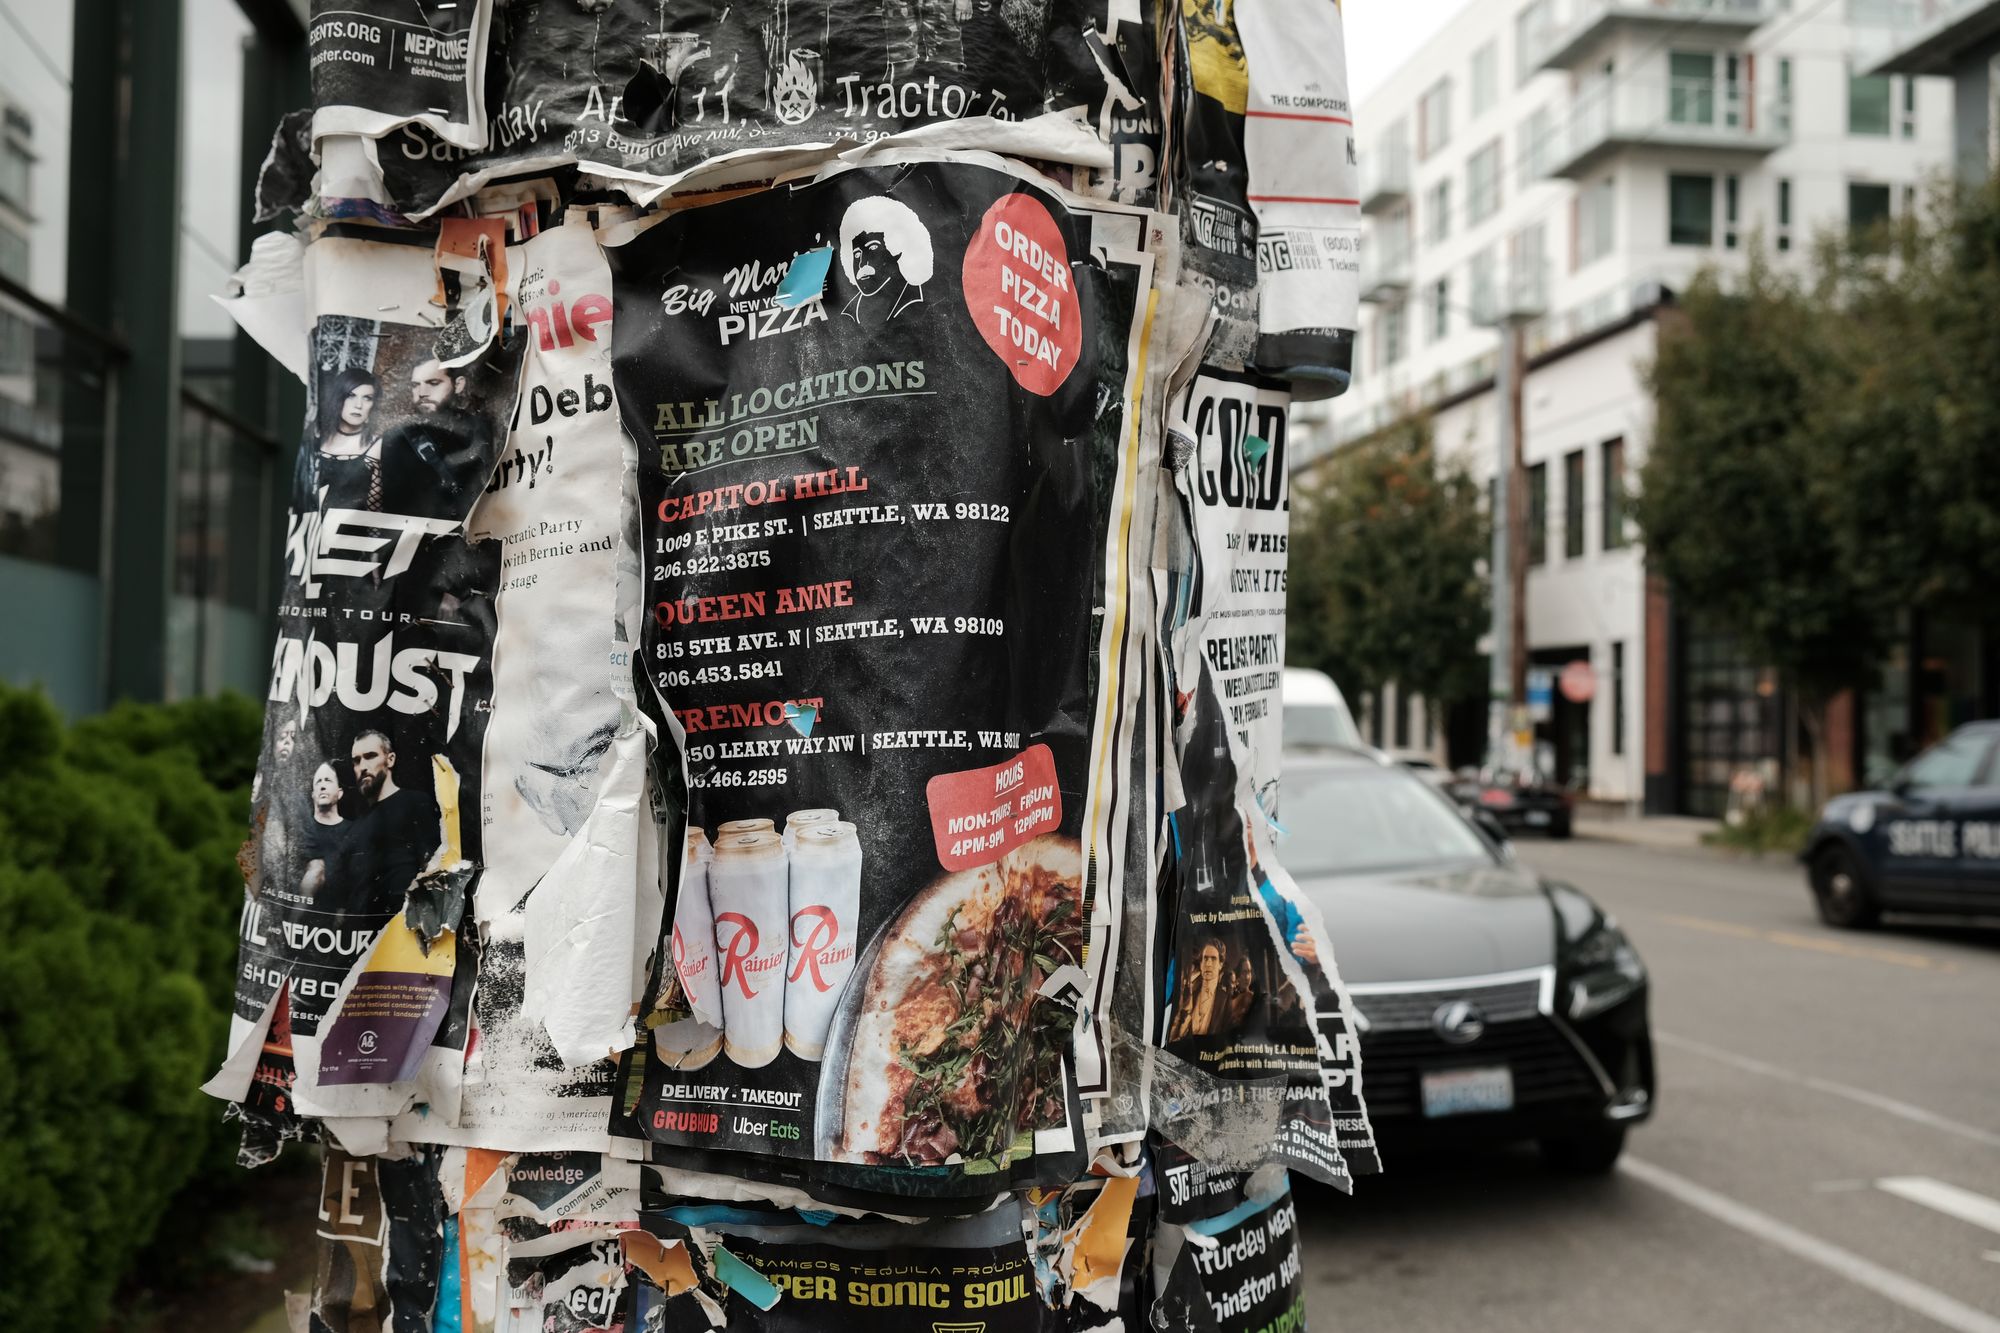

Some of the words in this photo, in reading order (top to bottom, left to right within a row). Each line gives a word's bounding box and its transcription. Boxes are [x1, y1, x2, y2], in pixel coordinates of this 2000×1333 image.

[837, 75, 981, 120] Tractor
[1271, 94, 1291, 107] THE
[562, 127, 600, 153] 5213
[994, 221, 1069, 293] ORDER
[661, 284, 717, 317] Big
[730, 299, 760, 315] NEW
[1001, 264, 1061, 331] PIZZA
[718, 299, 829, 346] PIZZA
[993, 305, 1062, 372] TODAY
[654, 400, 727, 431] ALL
[731, 360, 926, 420] LOCATIONS
[659, 434, 725, 471] ARE
[731, 416, 820, 456] OPEN
[656, 478, 787, 523] CAPITOL
[794, 466, 868, 500] HILL
[540, 519, 583, 538] Party
[656, 532, 692, 554] 1009
[695, 529, 708, 546] E
[712, 522, 760, 544] PIKE
[764, 518, 794, 537] ST.
[814, 505, 906, 530] SEATTLE,
[912, 503, 950, 521] WA
[955, 502, 1010, 523] 98122
[1247, 532, 1287, 553] WHIS
[503, 551, 527, 569] with
[530, 541, 574, 563] Bernie
[579, 535, 613, 554] and
[653, 550, 771, 581] 206.922.3875
[510, 571, 538, 590] stage
[342, 607, 412, 625] TOUR
[654, 591, 766, 632] QUEEN
[775, 580, 853, 620] ANNE
[656, 641, 684, 659] 815
[689, 637, 732, 656] 5TH
[736, 631, 785, 652] AVE.
[788, 629, 801, 646] N
[815, 619, 904, 645] SEATTLE,
[911, 618, 949, 635] WA
[953, 617, 1005, 636] 98109
[657, 660, 783, 688] 206.453.5841
[719, 738, 784, 759] LEARY
[785, 736, 825, 756] WAY
[827, 735, 855, 754] NW
[872, 730, 973, 752] SEATTLE,
[977, 731, 1003, 749] WA
[715, 911, 786, 1000] Rainier
[661, 1083, 730, 1101] DELIVERY
[741, 1087, 802, 1107] TAKEOUT
[653, 1109, 719, 1134] GRUBHUB
[733, 1116, 768, 1136] Uber
[769, 1120, 801, 1141] Eats
[590, 1197, 608, 1213] Ash
[765, 1272, 838, 1302] PER
[847, 1280, 951, 1310] SONIC
[963, 1273, 1031, 1310] SOUL
